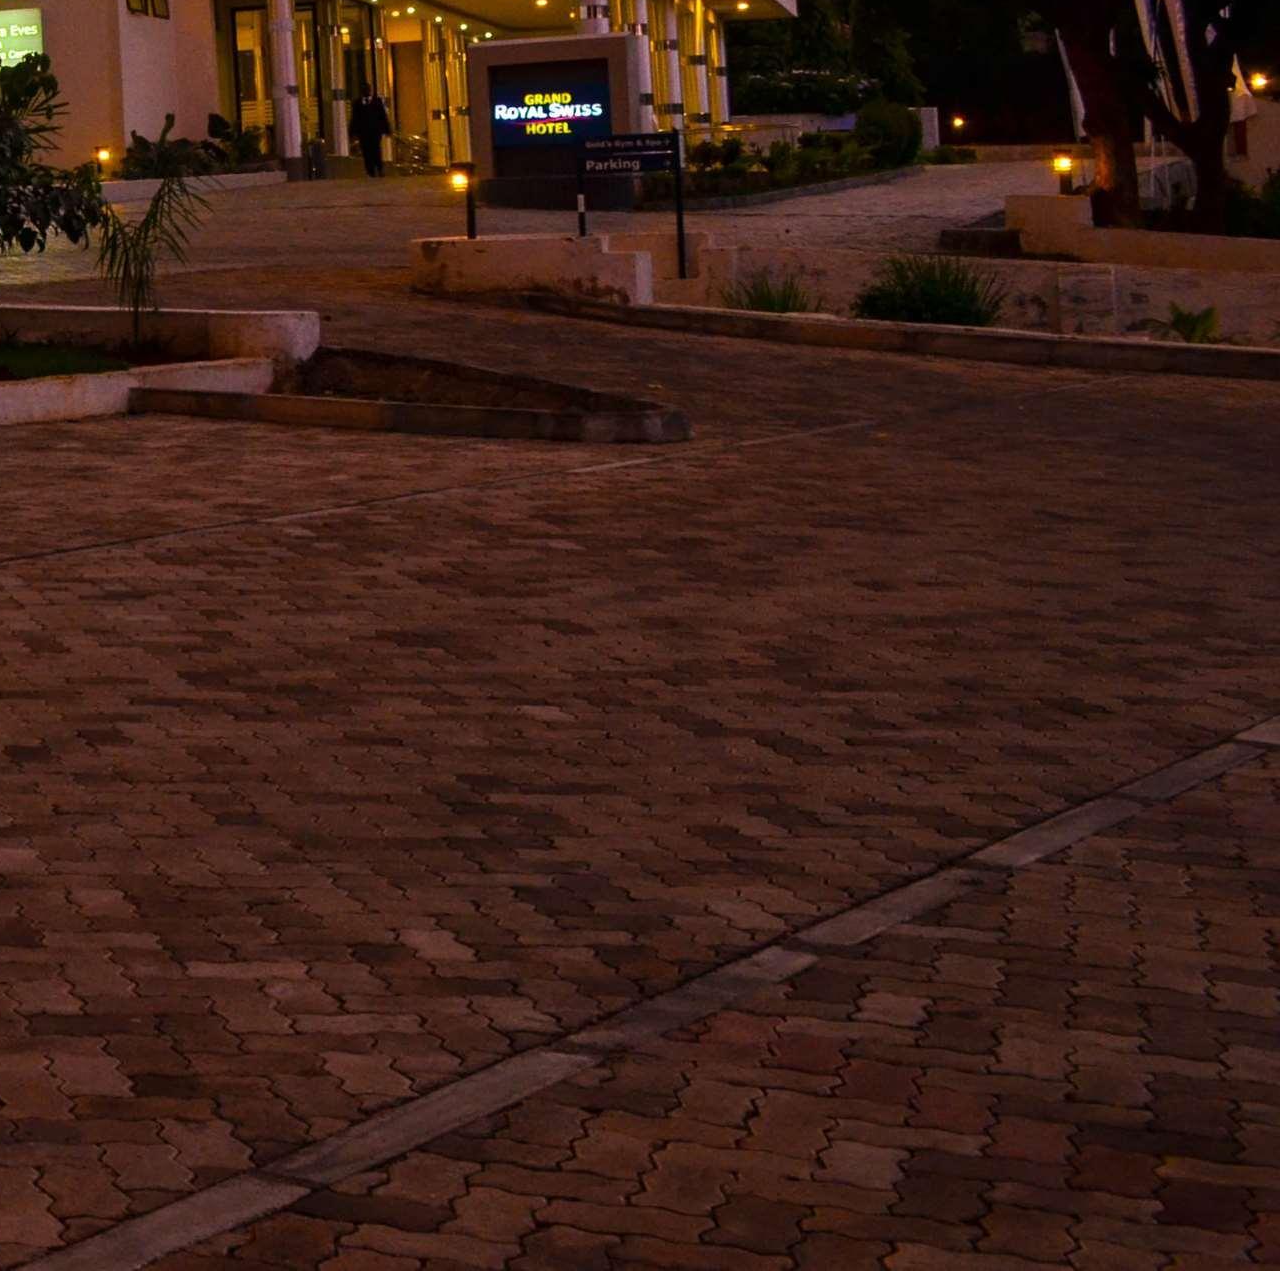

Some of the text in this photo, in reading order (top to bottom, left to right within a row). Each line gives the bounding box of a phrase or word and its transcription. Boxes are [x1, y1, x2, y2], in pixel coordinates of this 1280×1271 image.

[524, 93, 572, 106] GRAND
[494, 102, 603, 120] ROYAL SWISS
[525, 122, 572, 135] HOTEL
[585, 157, 641, 171] Parking
